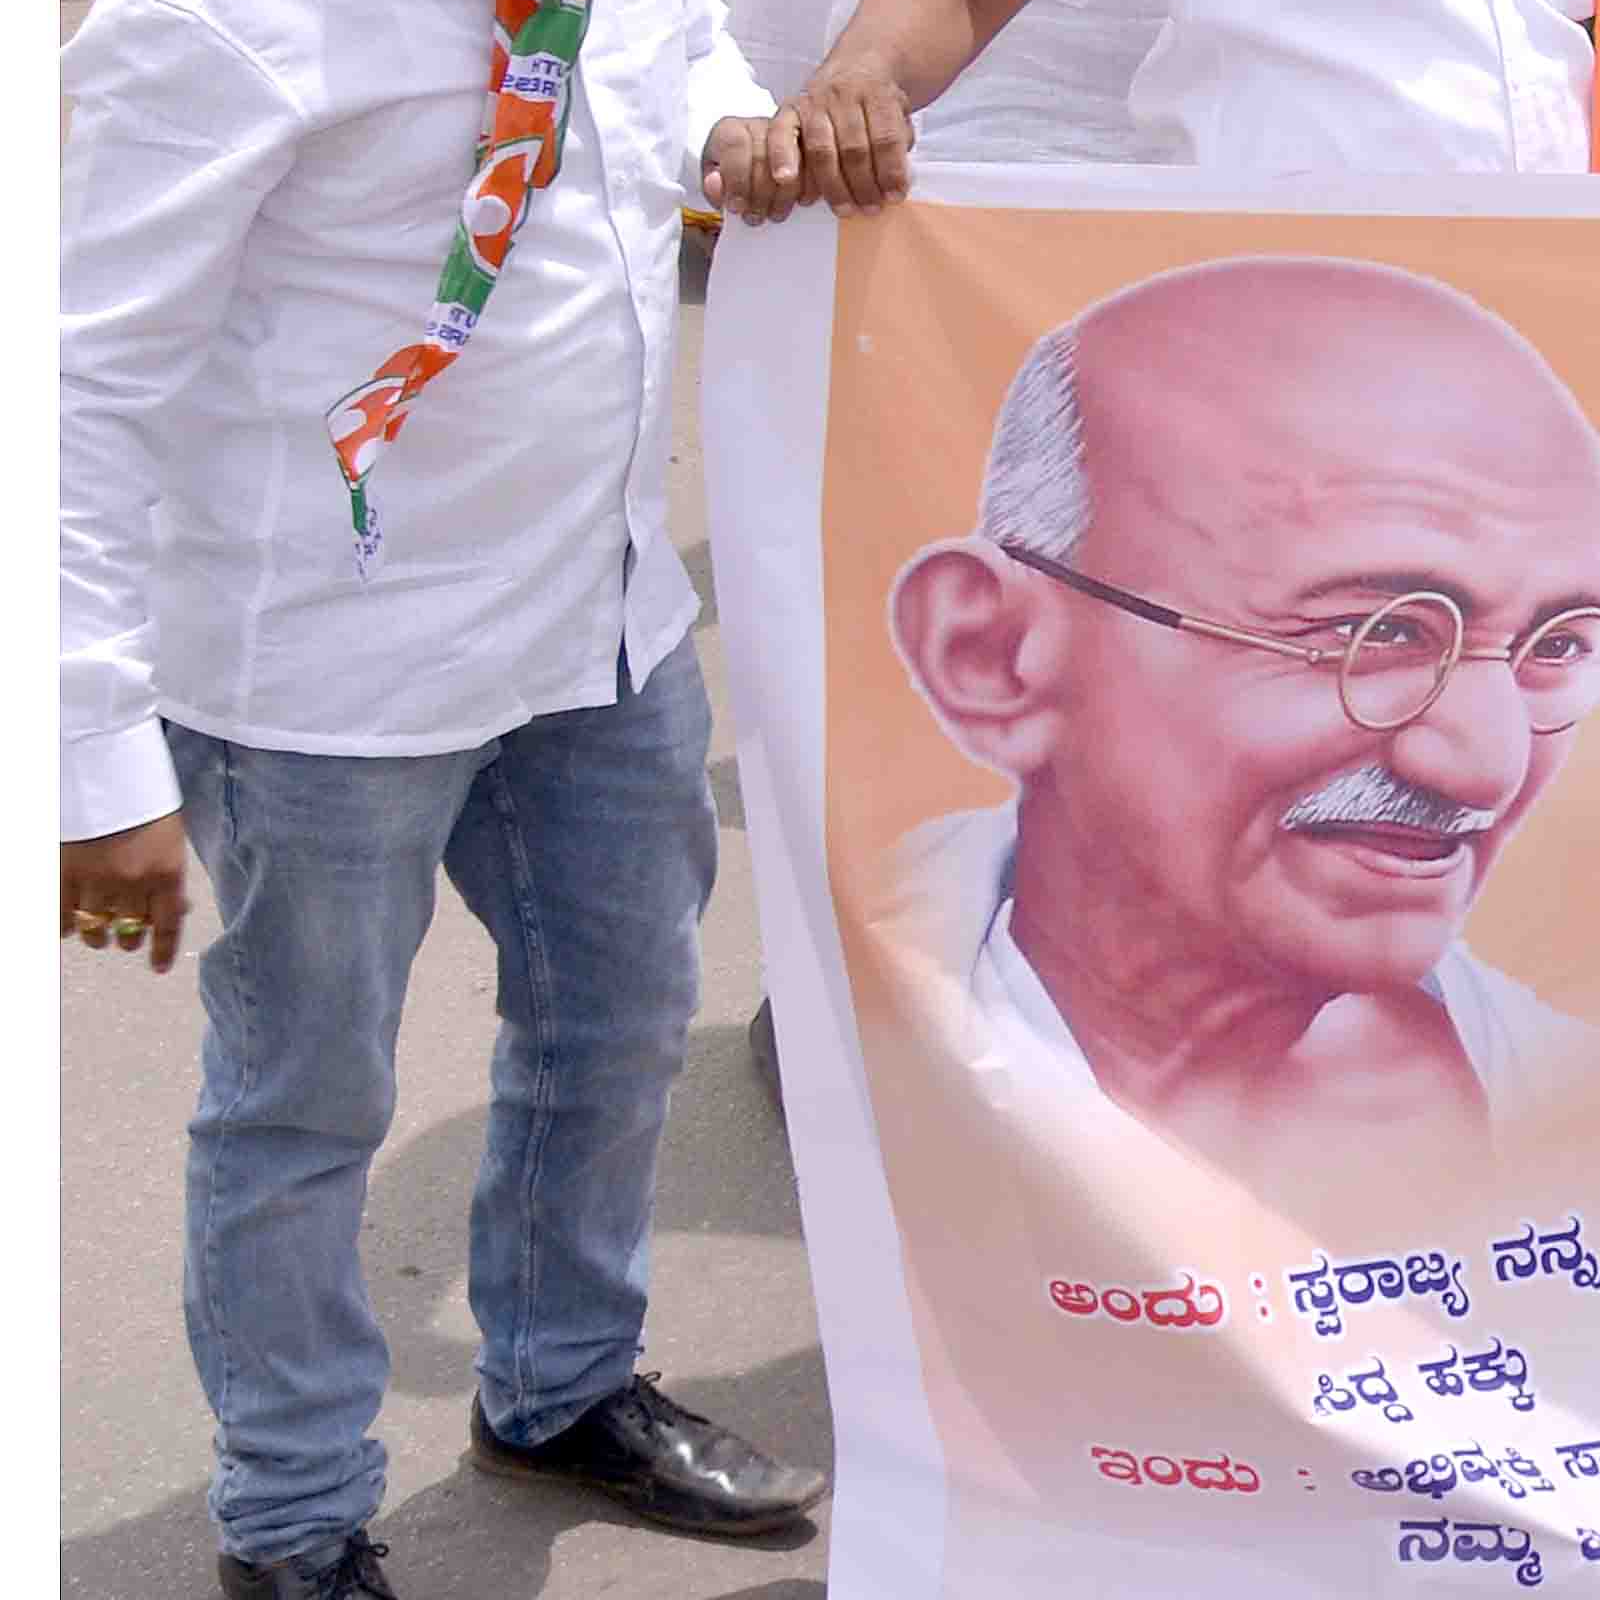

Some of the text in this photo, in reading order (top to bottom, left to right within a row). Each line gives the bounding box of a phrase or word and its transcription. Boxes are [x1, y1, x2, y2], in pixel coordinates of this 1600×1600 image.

[1048, 1272, 1224, 1328] ಅಂದು
[1290, 1252, 1469, 1336] ಸ್ವರಾಜ್ಯ
[1418, 1336, 1535, 1412] ಹಕ್ಕು
[1090, 1444, 1261, 1496] ಇಂದು
[1398, 1517, 1545, 1588] ನಮ್ಮ
